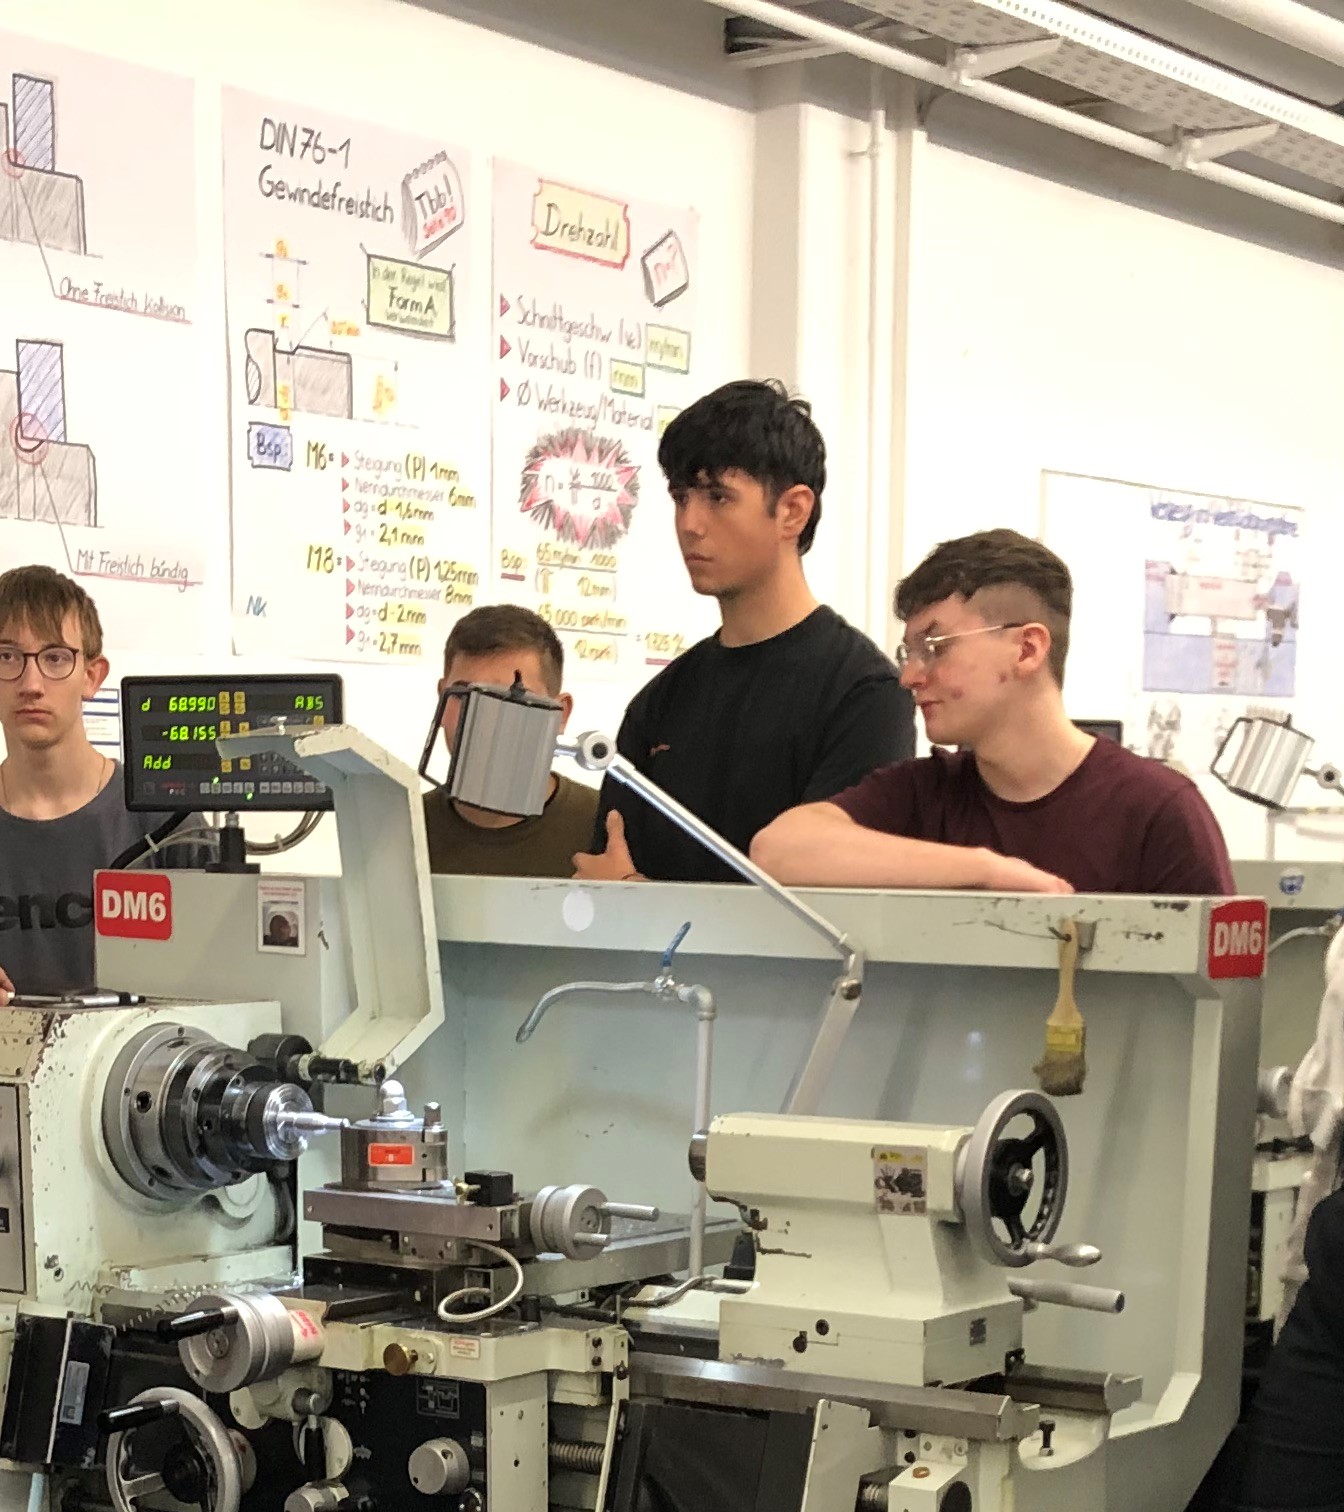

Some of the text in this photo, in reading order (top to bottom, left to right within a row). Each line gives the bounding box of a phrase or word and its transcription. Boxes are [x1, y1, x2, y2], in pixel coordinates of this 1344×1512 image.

[259, 117, 351, 169] DIN 76-1
[540, 202, 620, 251] Drehzahl
[388, 286, 437, 317] Form A
[517, 335, 577, 375] Vorschub
[405, 453, 427, 482] (P)
[98, 551, 144, 578] Freistich
[408, 555, 431, 583] (P)
[294, 695, 324, 711] ABS
[143, 755, 172, 770] Add
[101, 889, 167, 922] DM6
[1213, 920, 1263, 957] DM6
